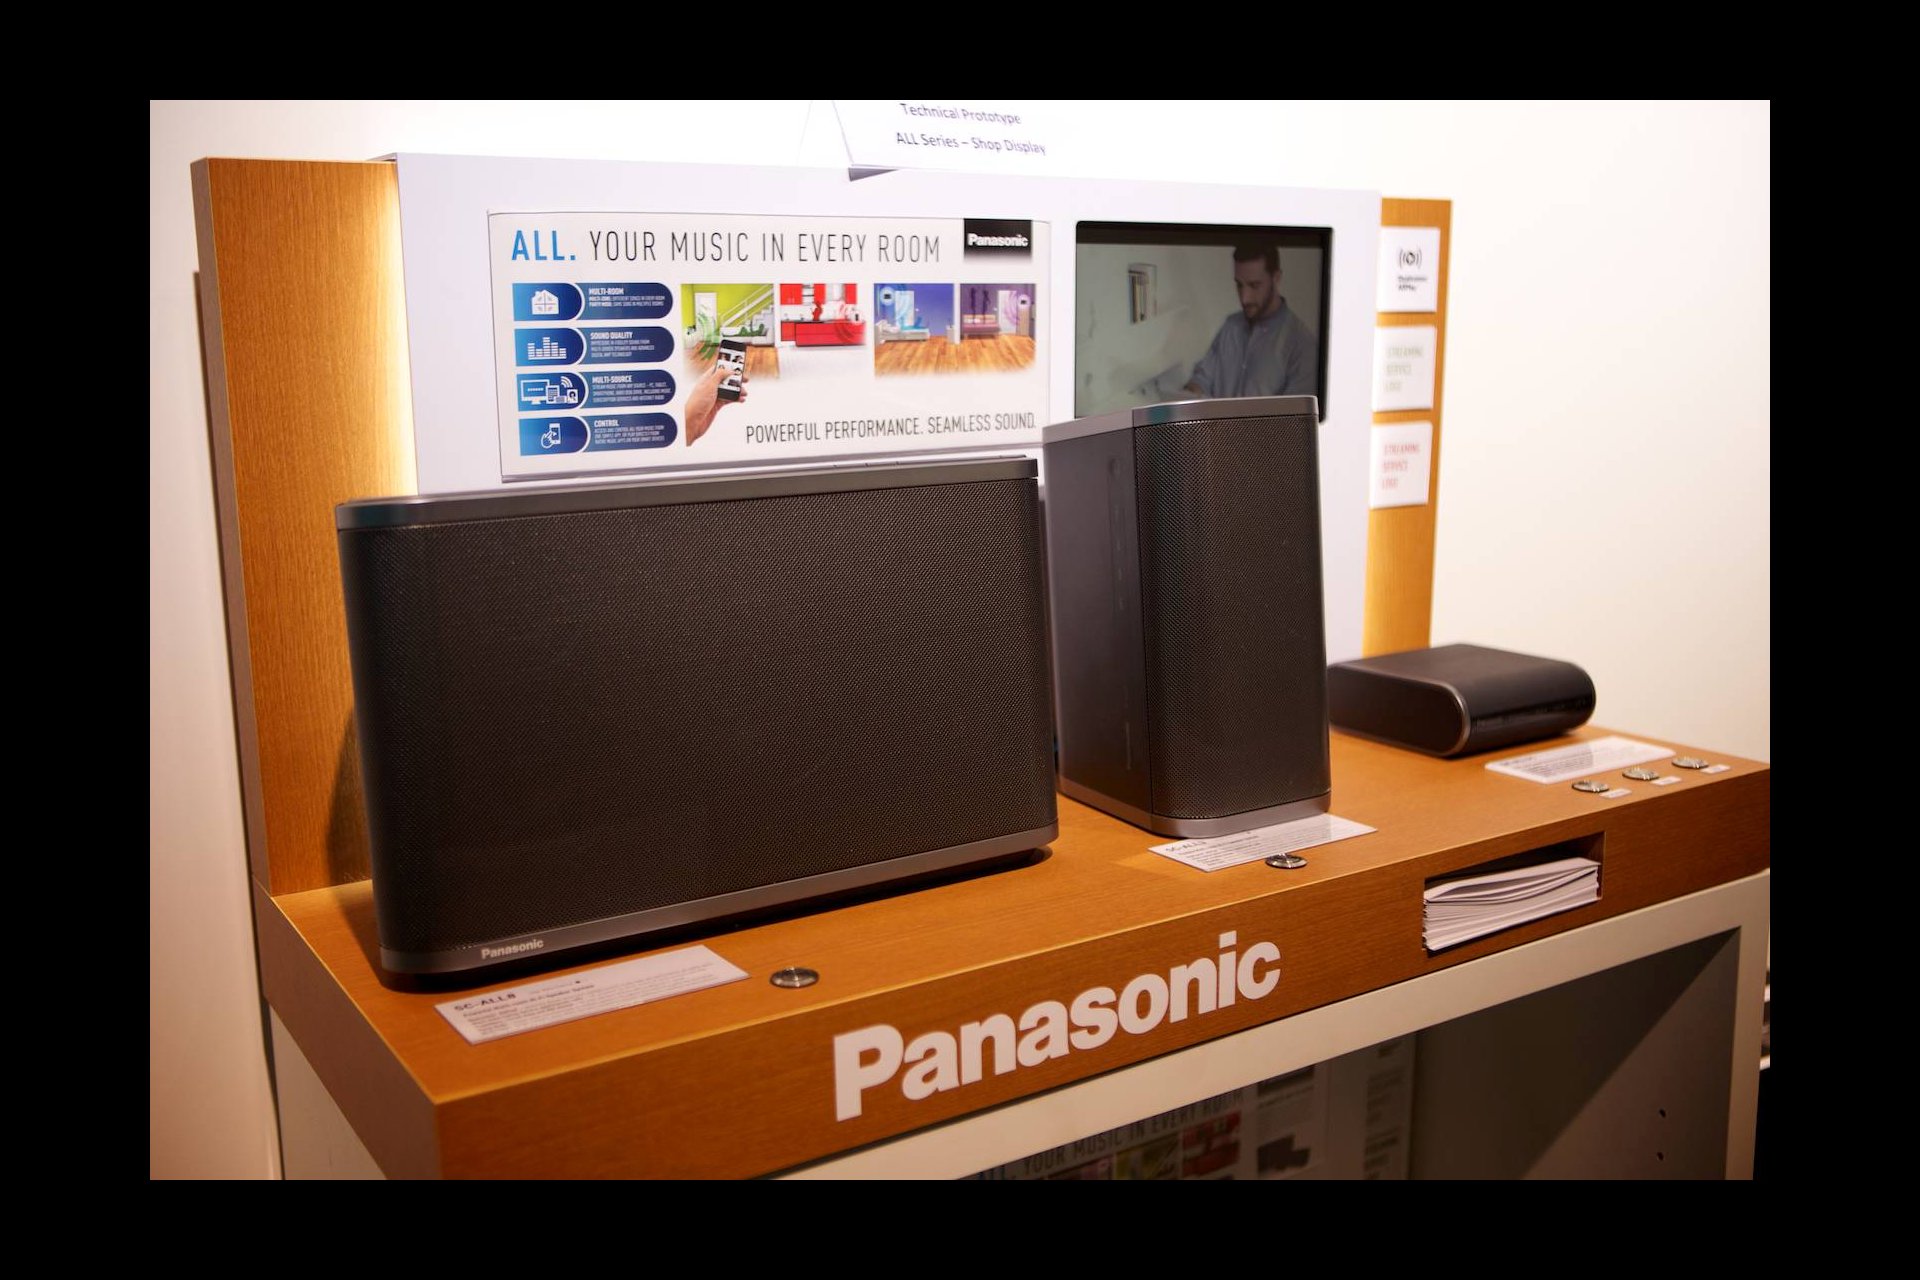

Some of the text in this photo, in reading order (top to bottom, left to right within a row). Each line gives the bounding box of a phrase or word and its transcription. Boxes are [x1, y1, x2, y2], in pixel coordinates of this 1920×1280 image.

[900, 102, 1021, 126] Technical Prototype
[896, 132, 918, 146] ALL
[920, 133, 959, 148] Series
[971, 136, 1002, 153] Shop
[1004, 138, 1047, 156] Display
[511, 229, 940, 263] ALL. YOUR MUSIC IN EVERY ROOM
[966, 232, 1029, 248] Panasonic
[588, 287, 625, 296] MULTI-ROOM
[590, 331, 633, 341] SOUND QUALITY
[592, 375, 633, 384] MULTI-SOURCE
[594, 419, 620, 428] CONTROL
[745, 411, 1037, 444] POWERFUL PERFORMANCE. SEAMLESS SOUND.
[480, 938, 545, 960] Panasonic
[833, 930, 1281, 1122] Panasonic
[1023, 1151, 1065, 1176] YOUR
[1073, 1133, 1122, 1158] MUSIC
[1129, 1126, 1146, 1145] IN
